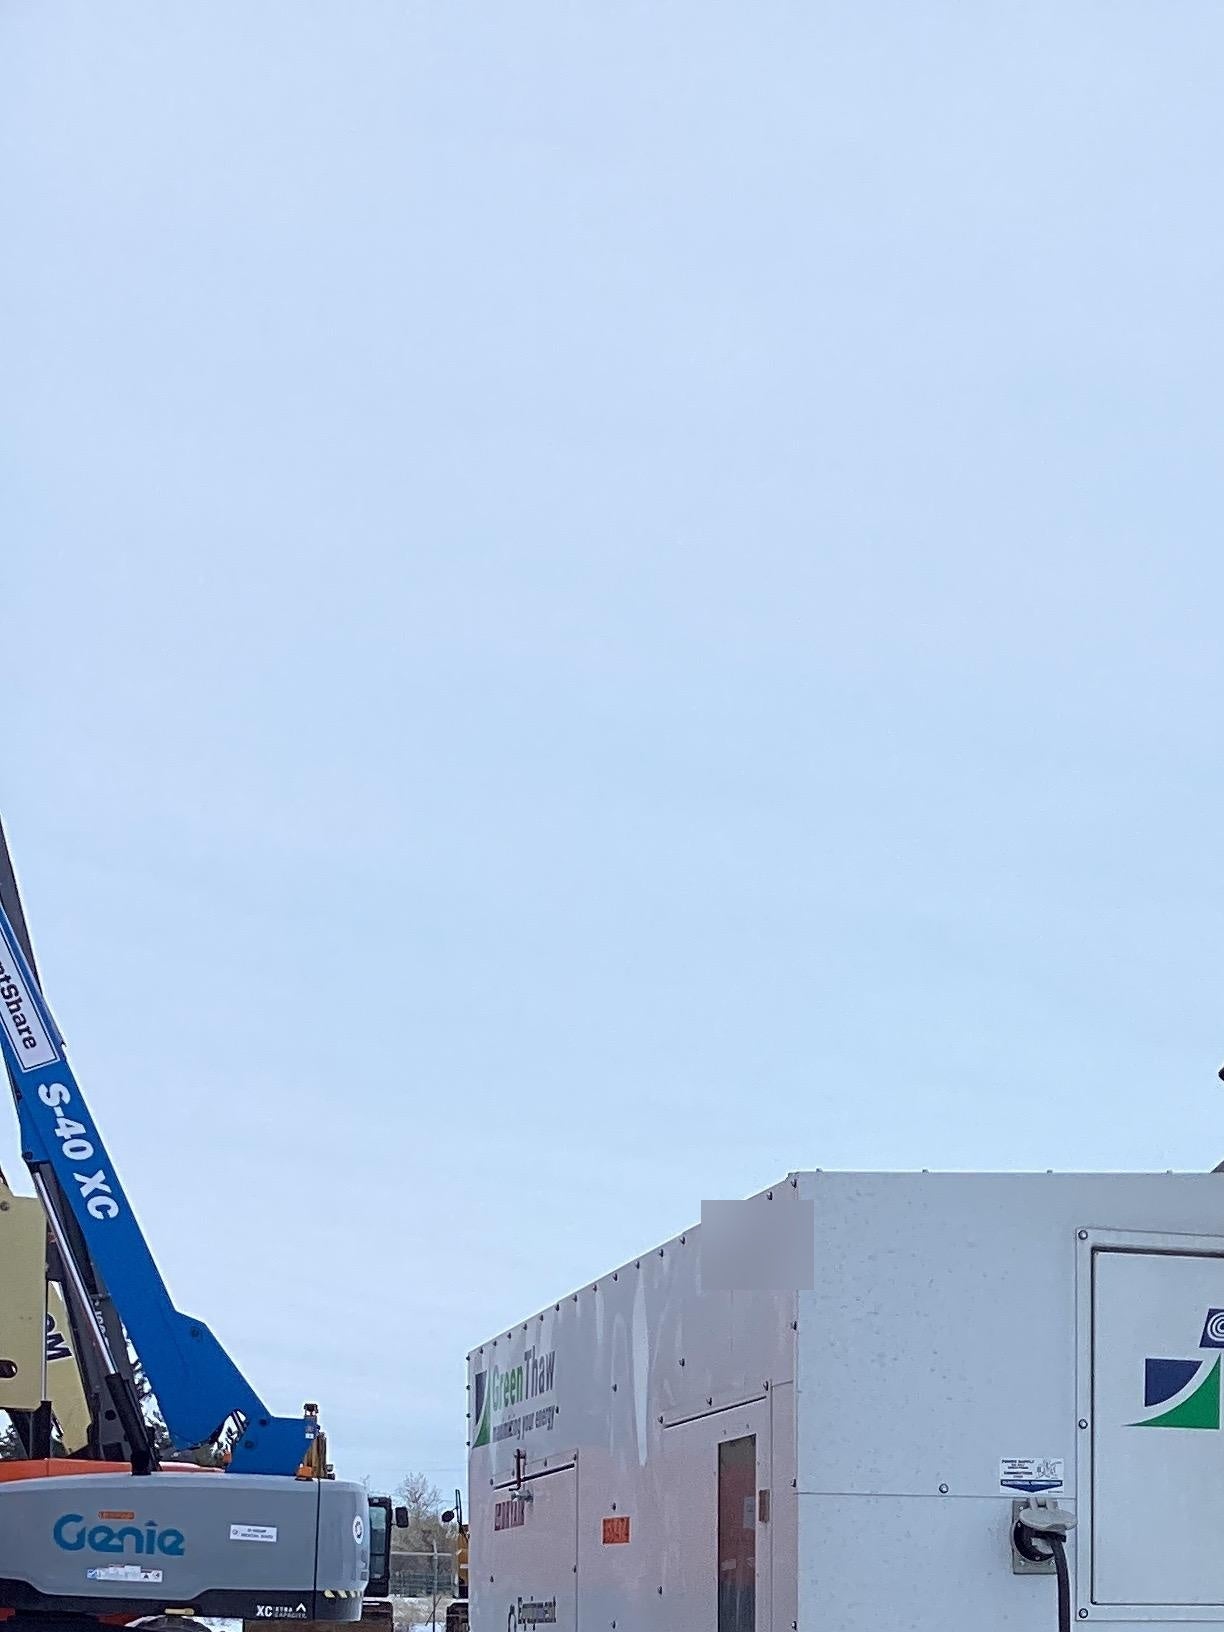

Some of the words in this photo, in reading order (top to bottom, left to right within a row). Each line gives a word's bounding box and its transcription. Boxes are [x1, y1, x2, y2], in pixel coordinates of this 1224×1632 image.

[37, 1081, 95, 1161] S-40
[72, 1169, 119, 1220] XC
[53, 1513, 185, 1556] Genie
[256, 1604, 273, 1617] XC
